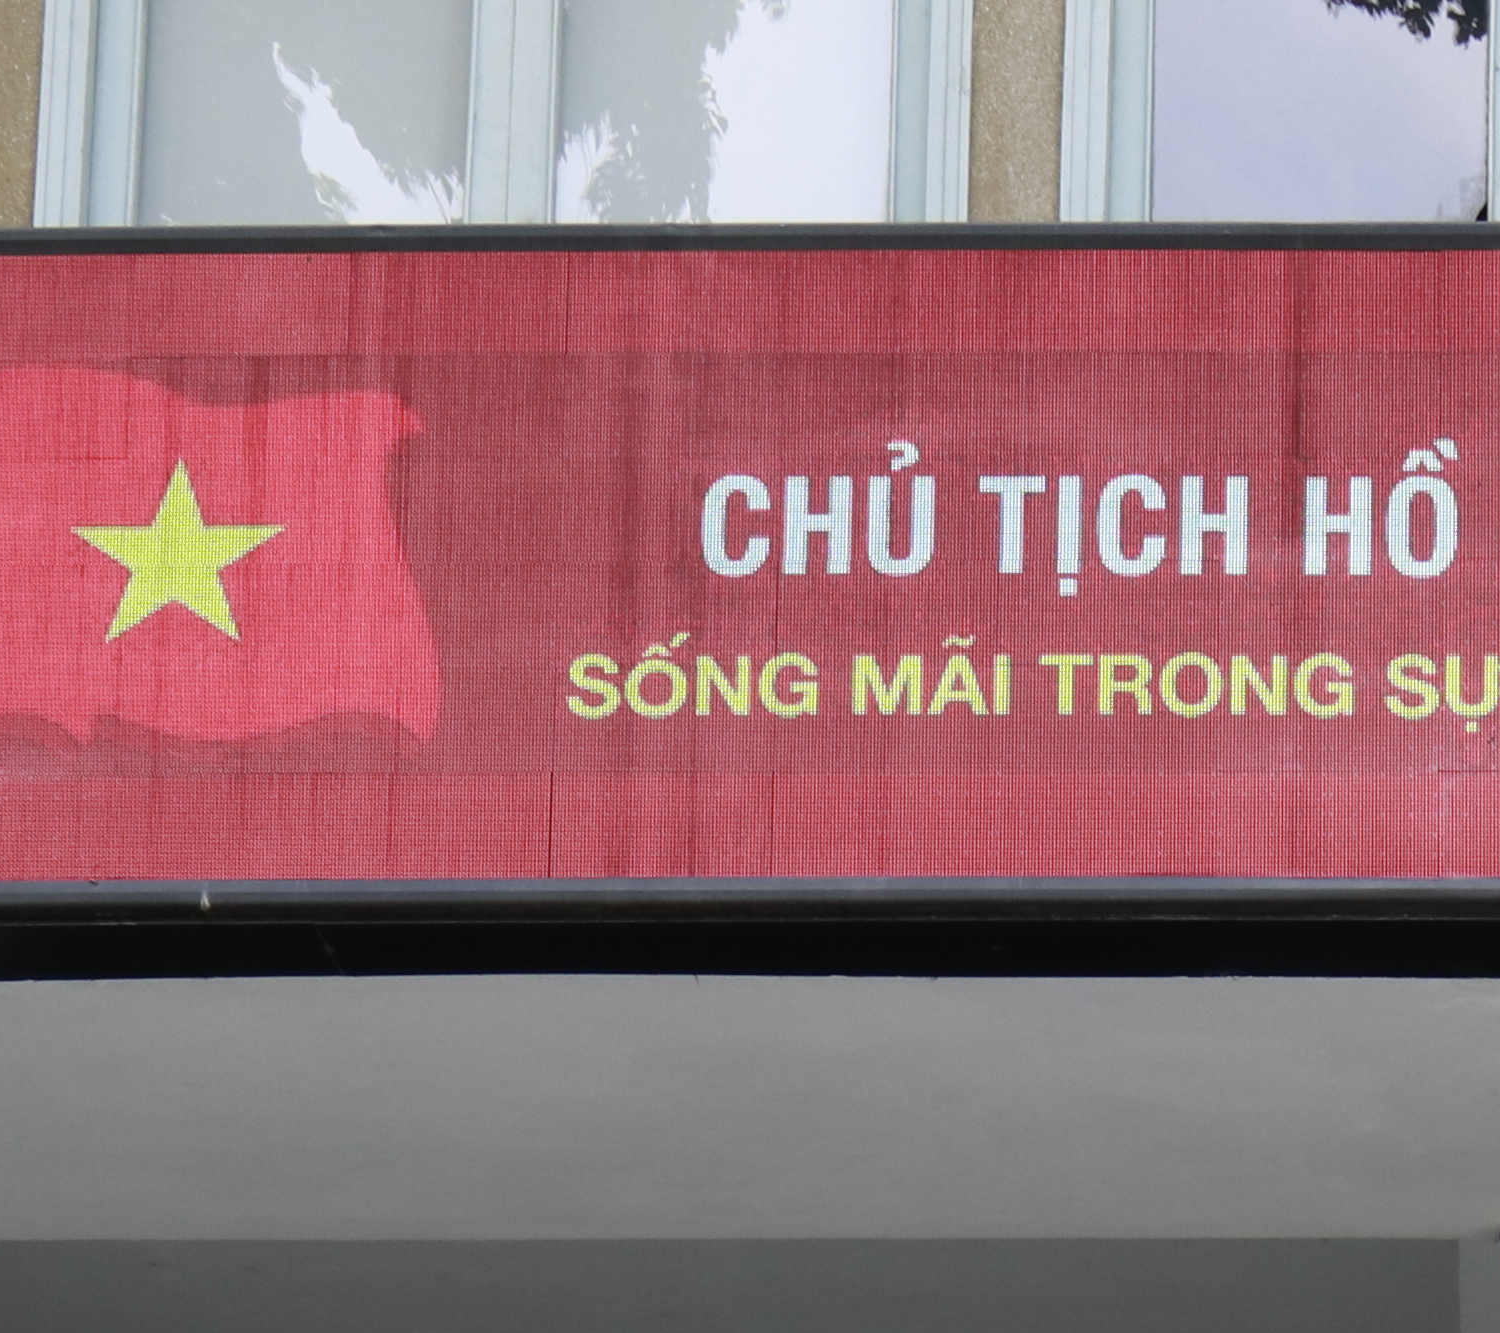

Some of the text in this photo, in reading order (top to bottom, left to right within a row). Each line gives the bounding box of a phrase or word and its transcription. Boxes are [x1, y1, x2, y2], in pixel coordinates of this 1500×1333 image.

[703, 441, 934, 577] CHỦ
[980, 475, 1248, 596] TỊCH
[1304, 440, 1458, 578] HỒ
[567, 633, 819, 719] SỐNG
[853, 636, 1011, 716] MÃI
[1040, 653, 1355, 719] TRONG
